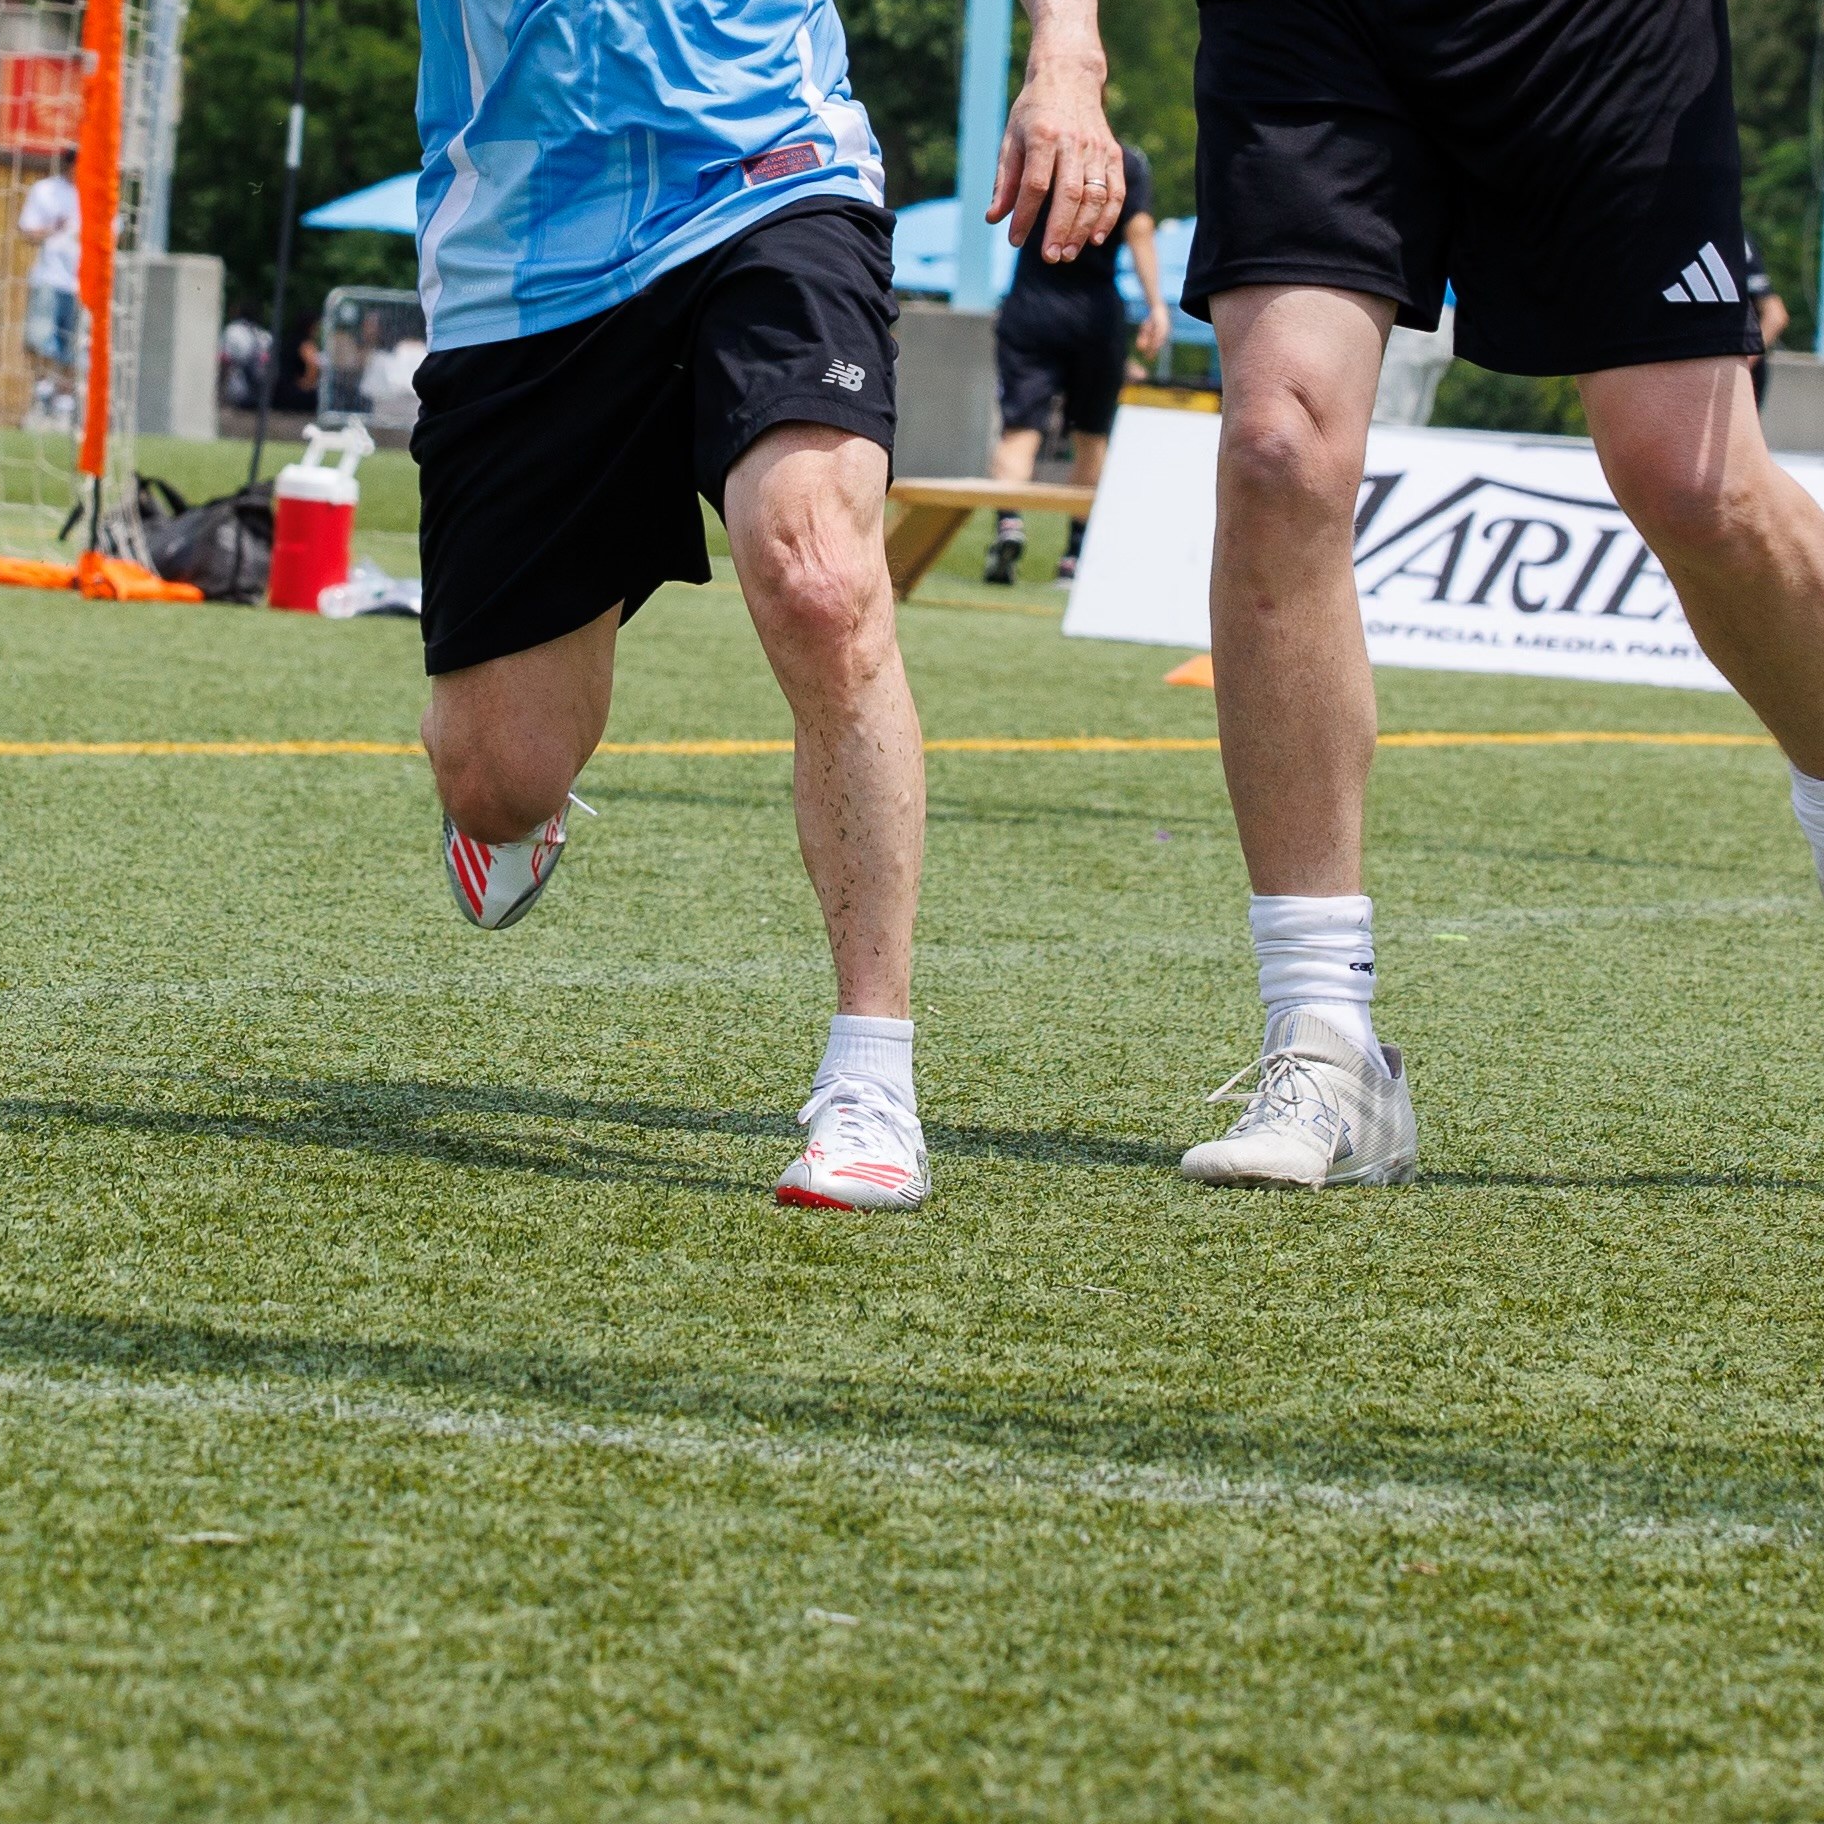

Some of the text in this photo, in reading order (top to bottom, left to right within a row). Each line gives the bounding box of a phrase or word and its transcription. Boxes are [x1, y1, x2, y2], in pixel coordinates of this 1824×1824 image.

[1354, 472, 1684, 621] VARIE
[1514, 633, 1616, 654] MEDIA
[1626, 640, 1704, 659] PART
